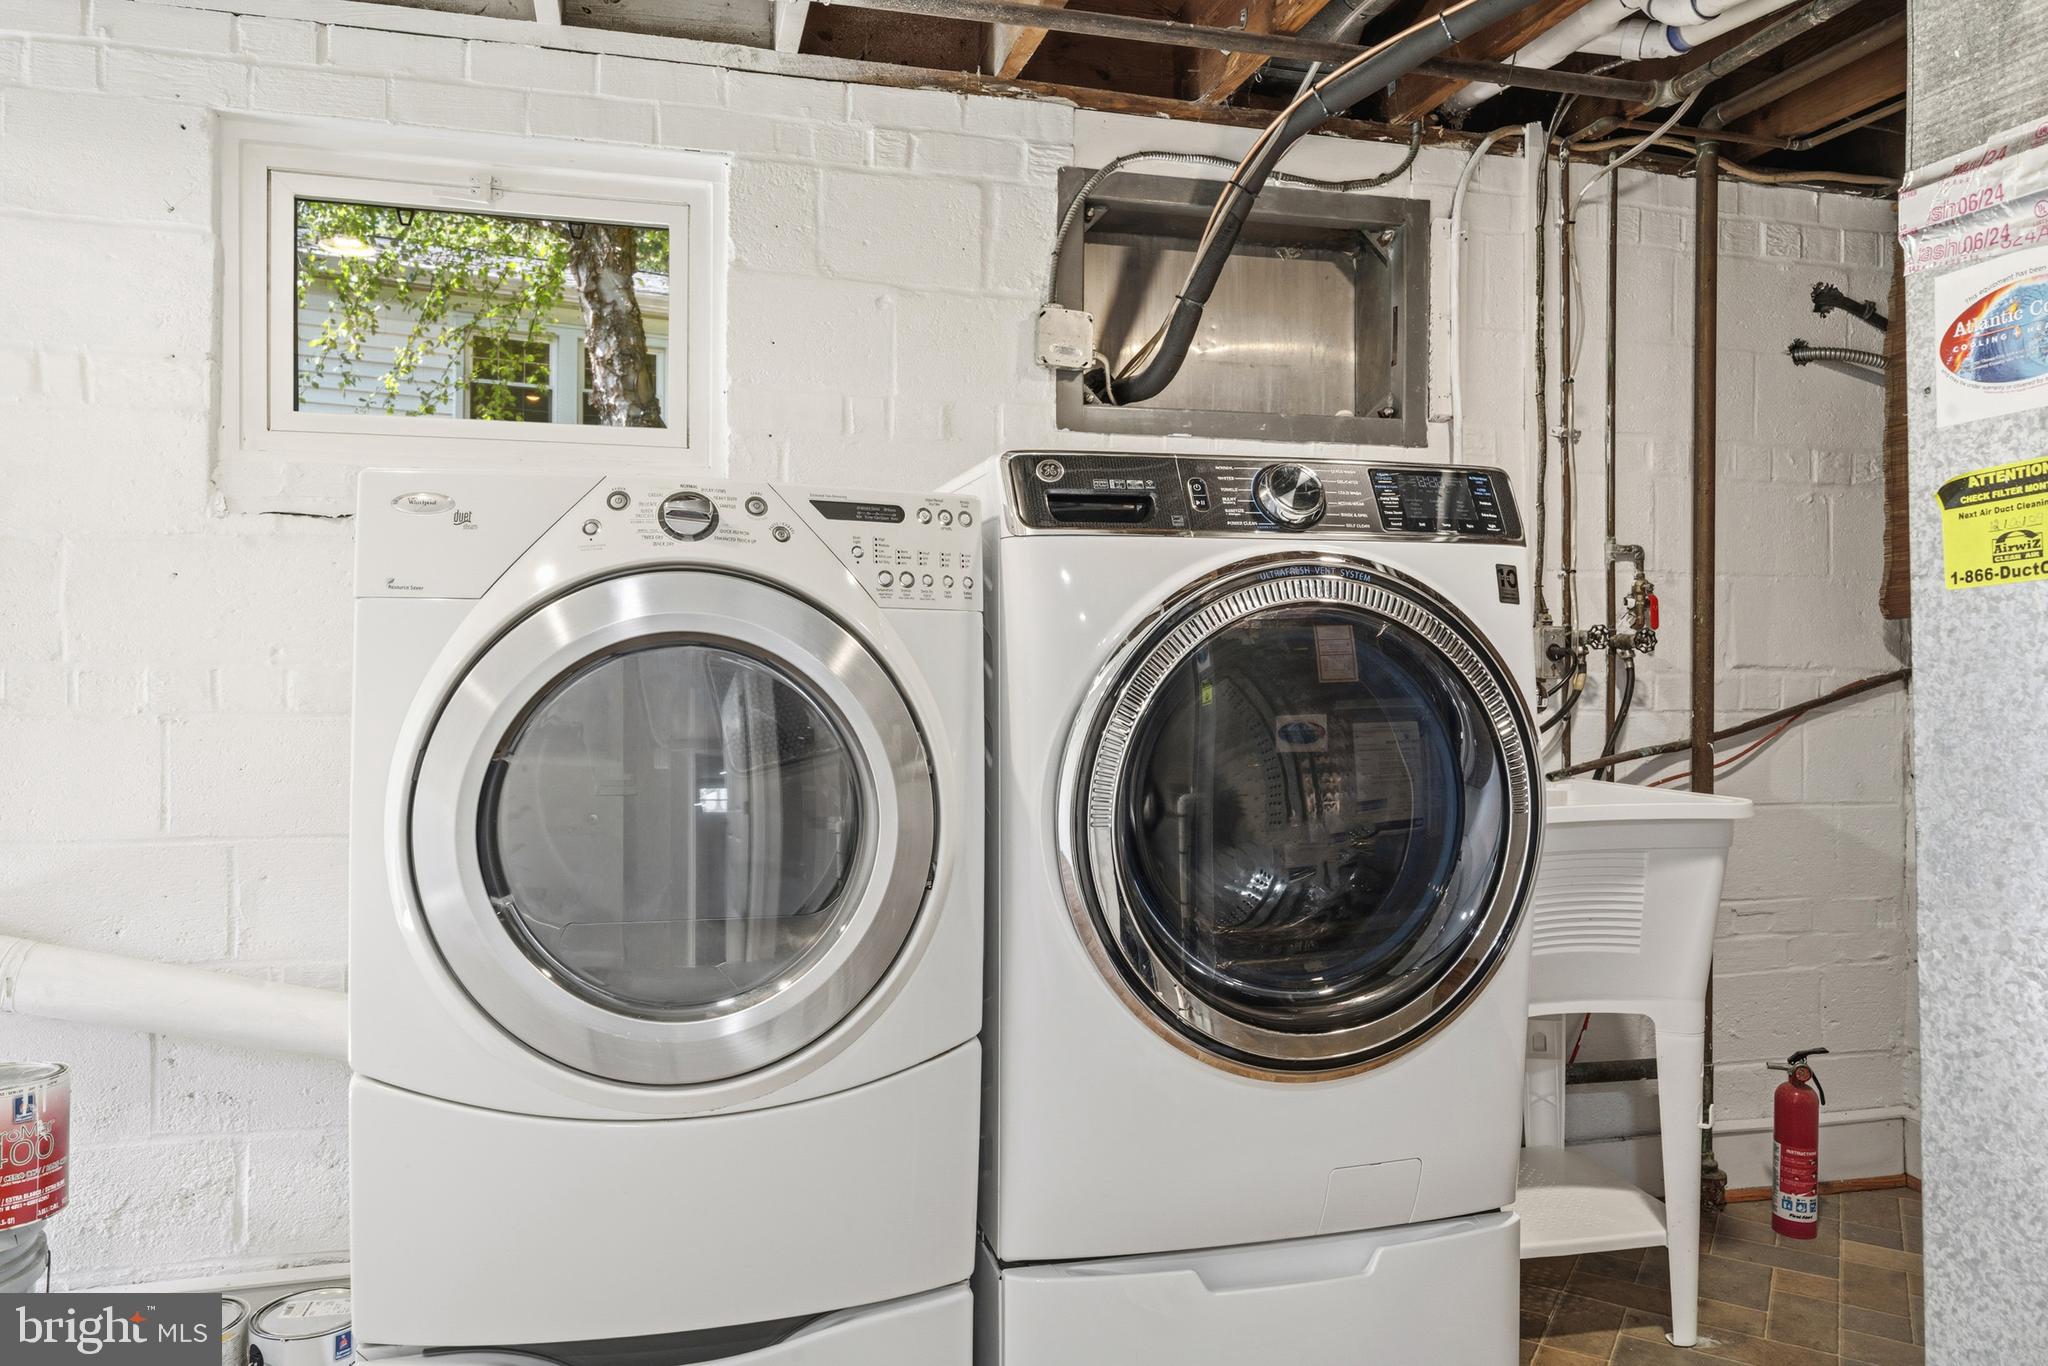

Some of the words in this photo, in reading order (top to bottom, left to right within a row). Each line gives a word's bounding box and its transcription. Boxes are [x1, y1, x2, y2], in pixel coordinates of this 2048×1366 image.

[1953, 307, 2023, 338] Atlantic
[1952, 333, 2008, 353] COOLING
[1959, 491, 1991, 505] CHECK
[1991, 486, 2024, 500] FILTER
[453, 509, 473, 523] duet
[1958, 512, 1978, 520] Next
[1979, 508, 1993, 517] Air
[1994, 505, 2015, 514] Duct
[1993, 553, 2022, 563] CLEAN
[1314, 567, 1336, 575] VENT
[1340, 568, 1371, 583] SYSTEM
